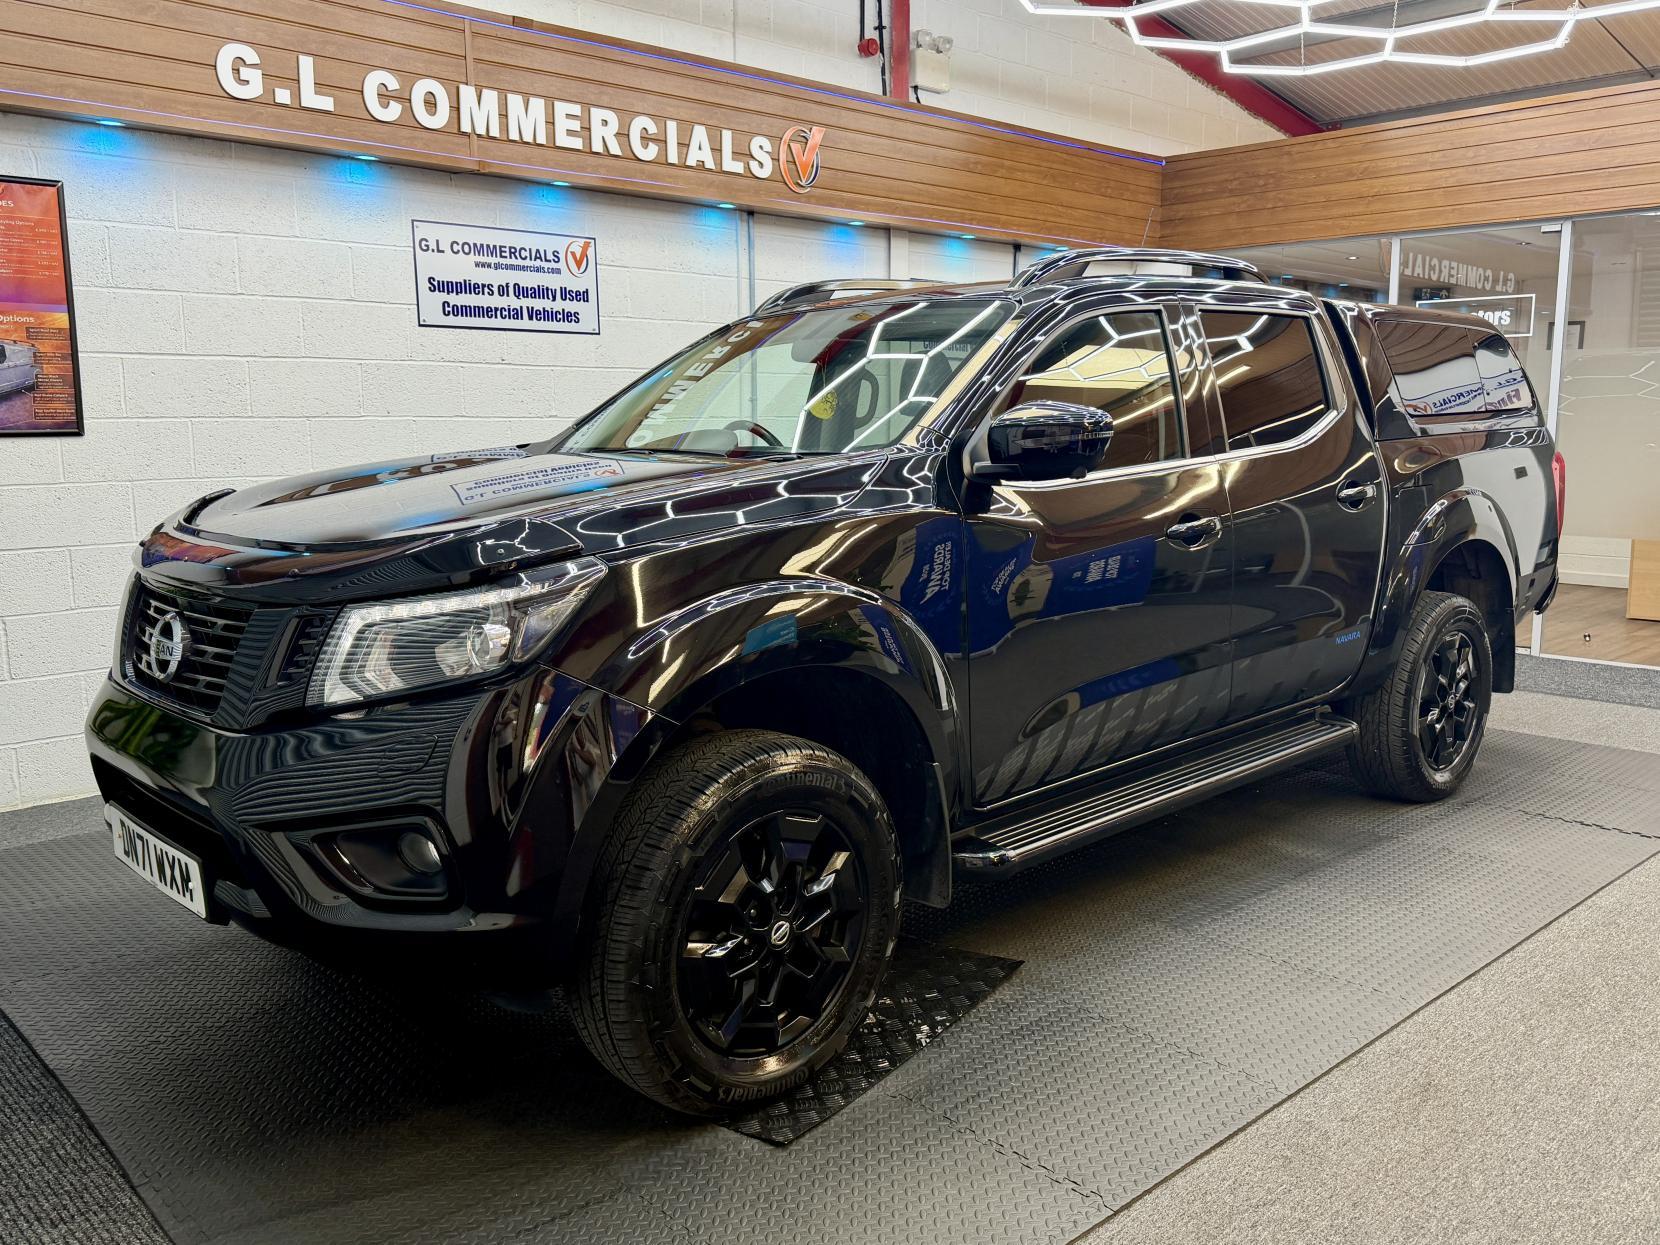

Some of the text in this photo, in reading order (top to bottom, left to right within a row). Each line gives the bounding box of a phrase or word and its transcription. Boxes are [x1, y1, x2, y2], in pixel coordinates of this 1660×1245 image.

[215, 42, 774, 180] G.L COMMERCIALS
[418, 237, 561, 264] G.L COMMERCIALS
[474, 260, 562, 275] www.glcommercials.com
[427, 276, 590, 303] Suppliers of Quality Used
[441, 301, 581, 324] Commercial Vehicles
[1335, 631, 1361, 645] NAVARA
[120, 818, 194, 903] DN71 WXM
